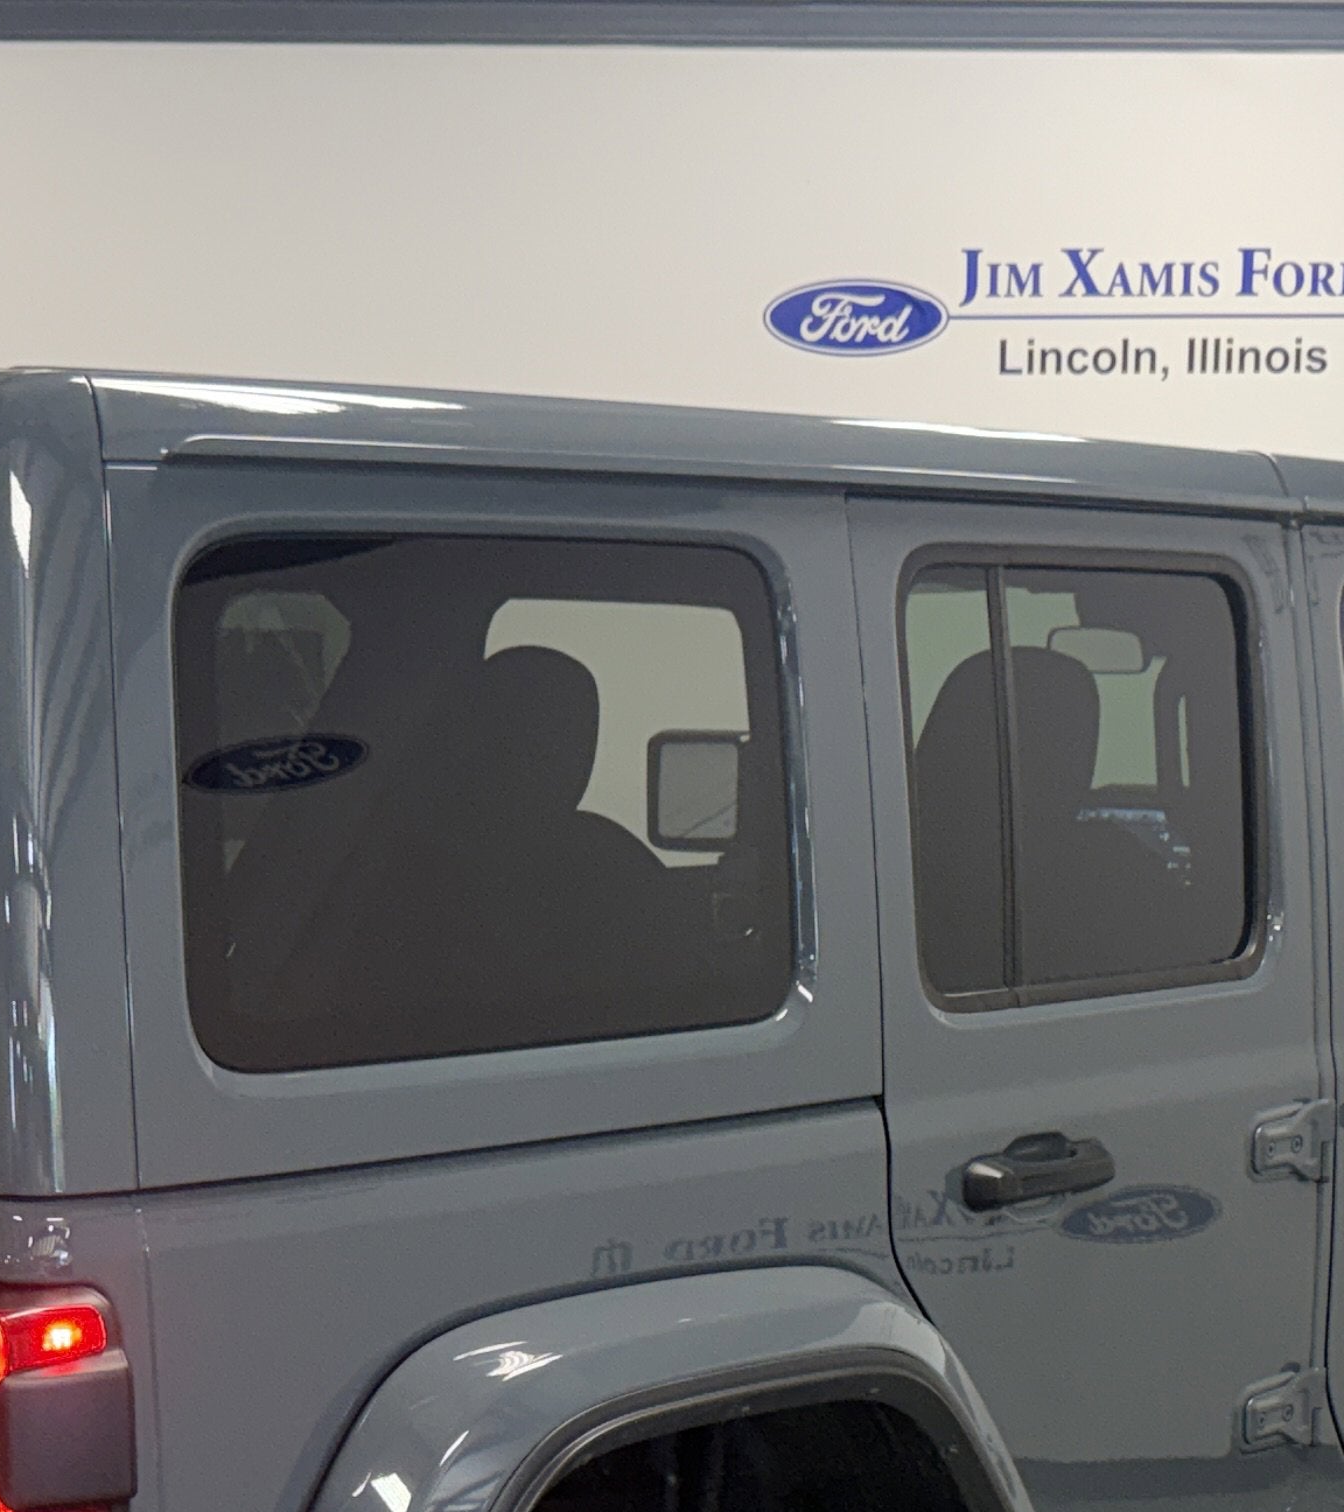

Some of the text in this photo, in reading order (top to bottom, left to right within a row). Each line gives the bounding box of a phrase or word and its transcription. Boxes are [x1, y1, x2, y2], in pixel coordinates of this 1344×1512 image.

[958, 248, 1042, 308] JIM
[1058, 247, 1221, 298] XAMIS
[799, 291, 913, 342] Ford
[998, 337, 1329, 382] Lincoln, Illinois
